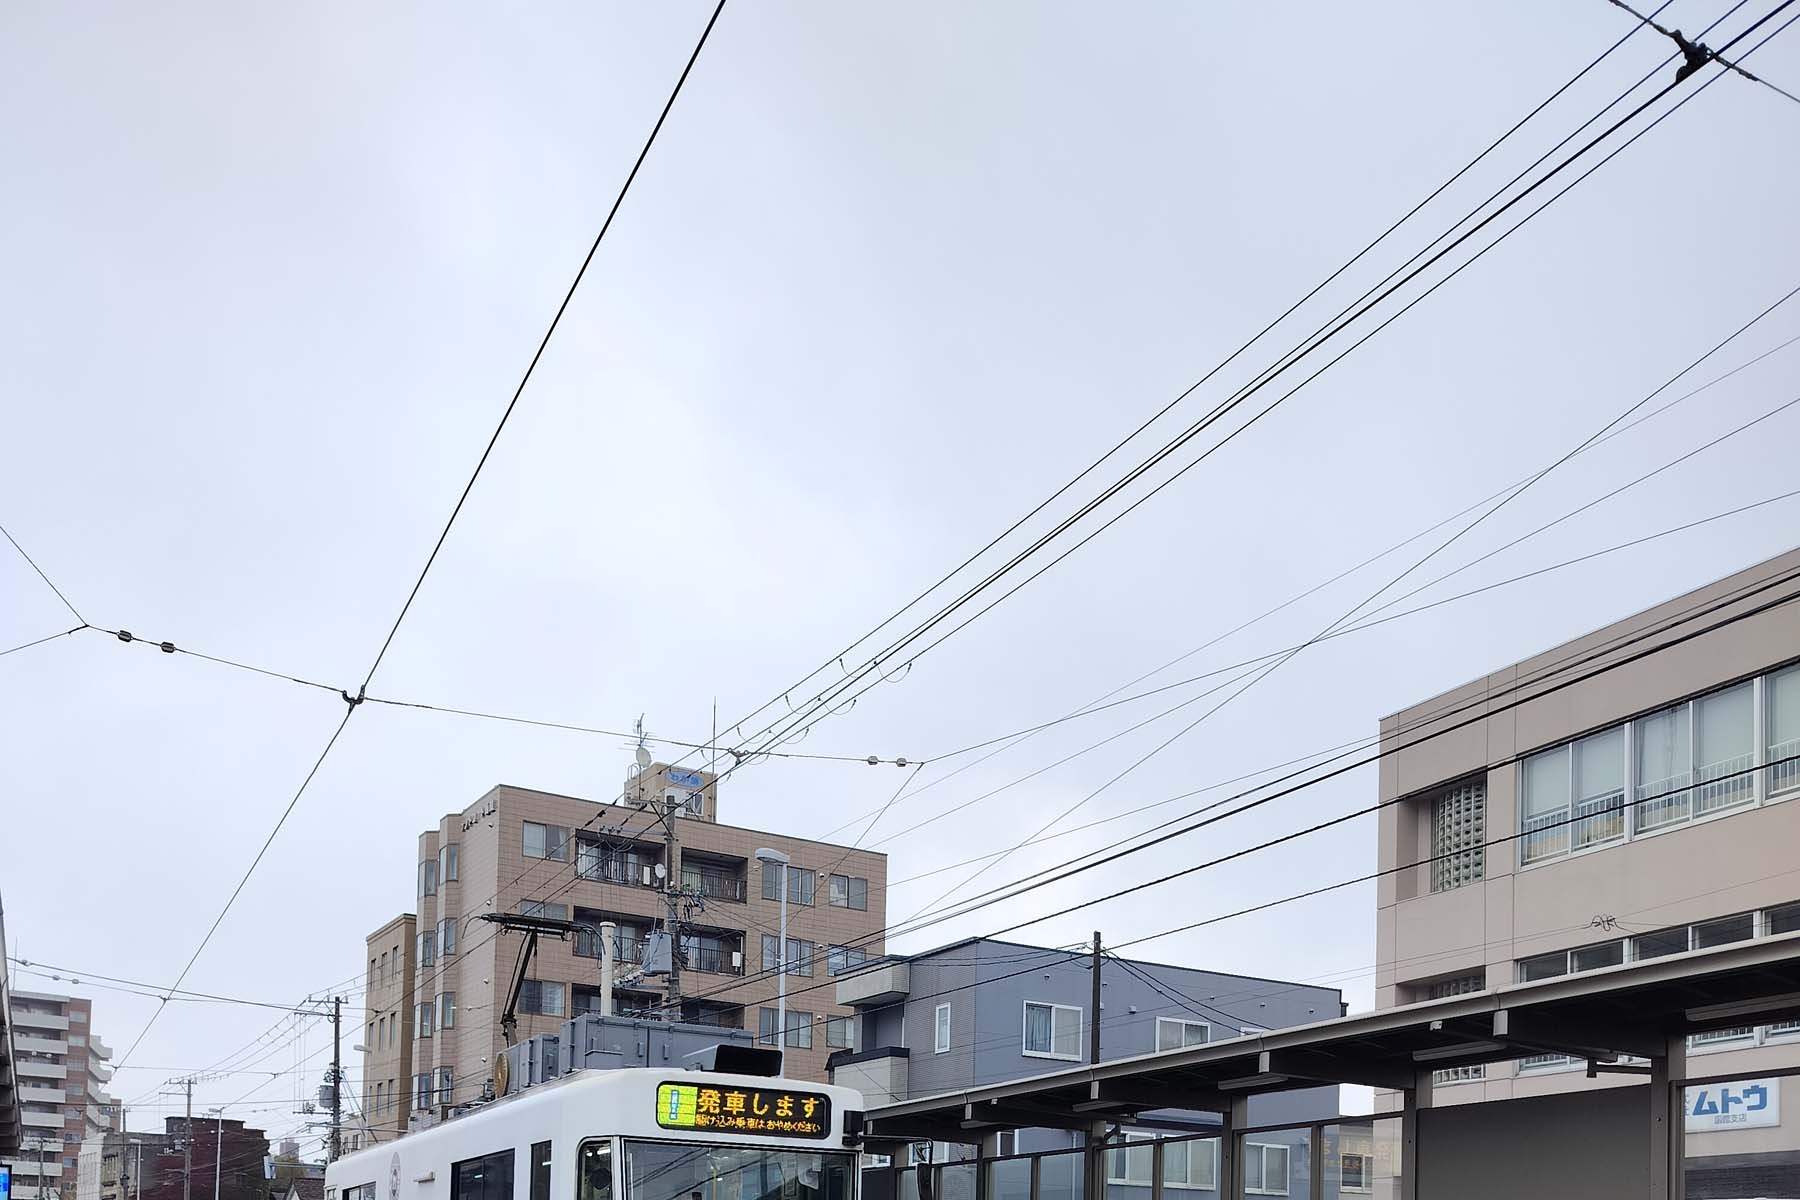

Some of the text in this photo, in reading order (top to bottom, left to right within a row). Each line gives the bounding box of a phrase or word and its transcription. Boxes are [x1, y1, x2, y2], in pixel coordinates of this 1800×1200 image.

[697, 1088, 820, 1119] 発車します
[1692, 1084, 1768, 1116] ムトウ
